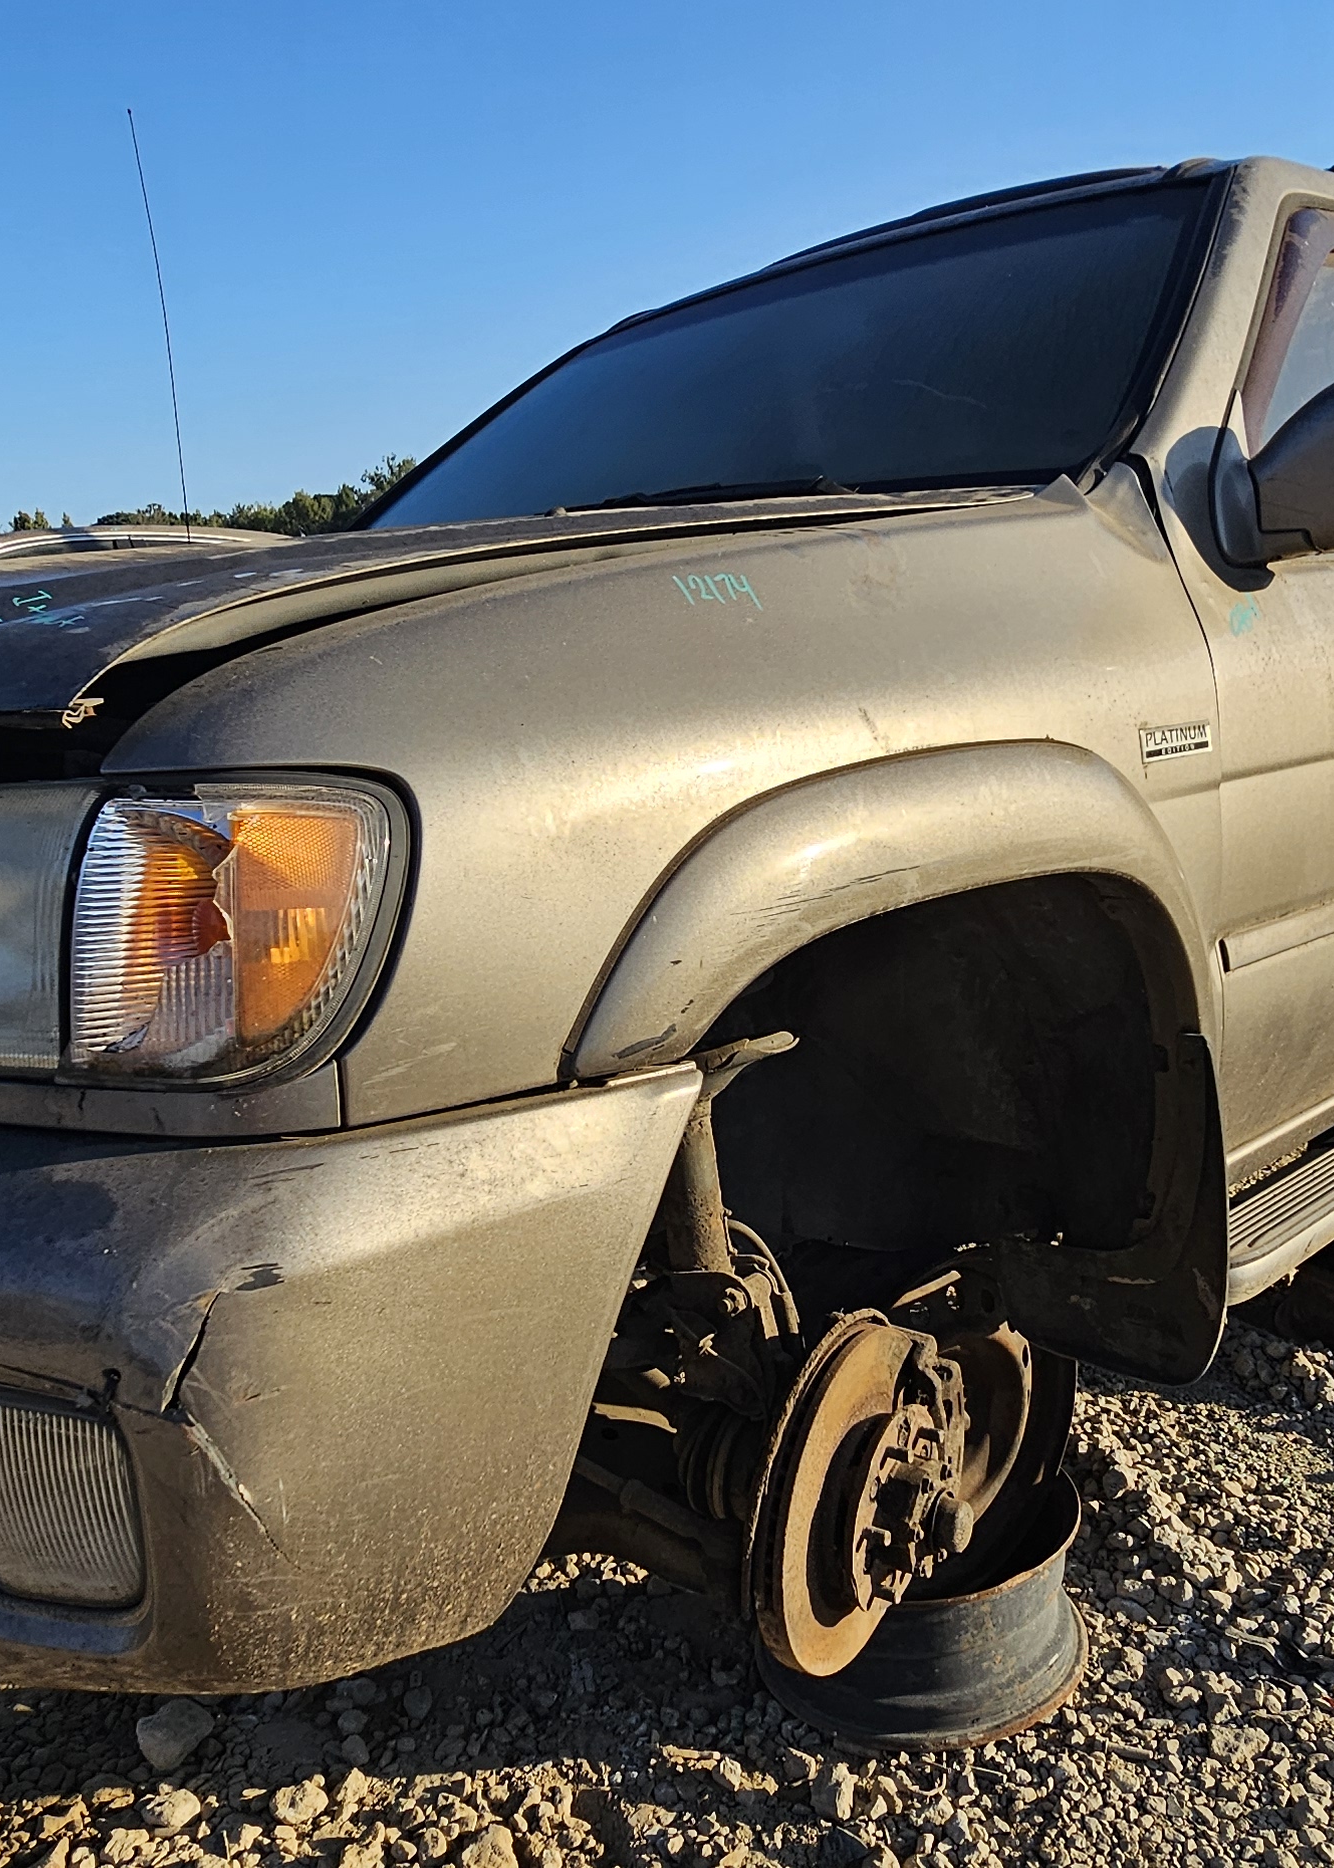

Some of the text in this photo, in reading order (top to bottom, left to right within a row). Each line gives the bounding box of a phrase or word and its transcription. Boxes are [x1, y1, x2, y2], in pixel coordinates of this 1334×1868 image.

[671, 572, 764, 612] 12174
[1145, 723, 1208, 748] PLATINUM
[1161, 743, 1196, 755] EDITION
